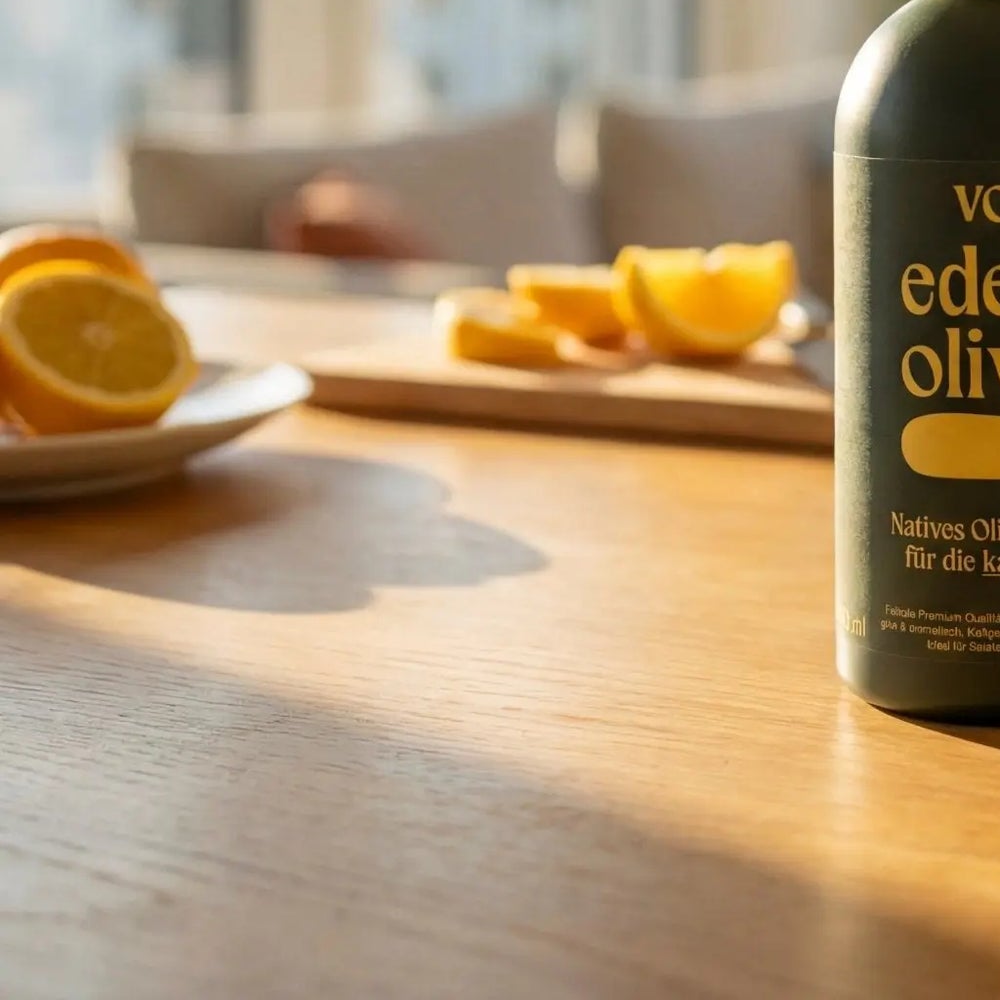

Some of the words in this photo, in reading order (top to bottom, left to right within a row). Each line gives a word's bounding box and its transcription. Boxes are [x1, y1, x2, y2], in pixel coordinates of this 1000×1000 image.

[891, 511, 966, 541] Natives
[905, 544, 937, 570] für
[942, 547, 976, 572] die
